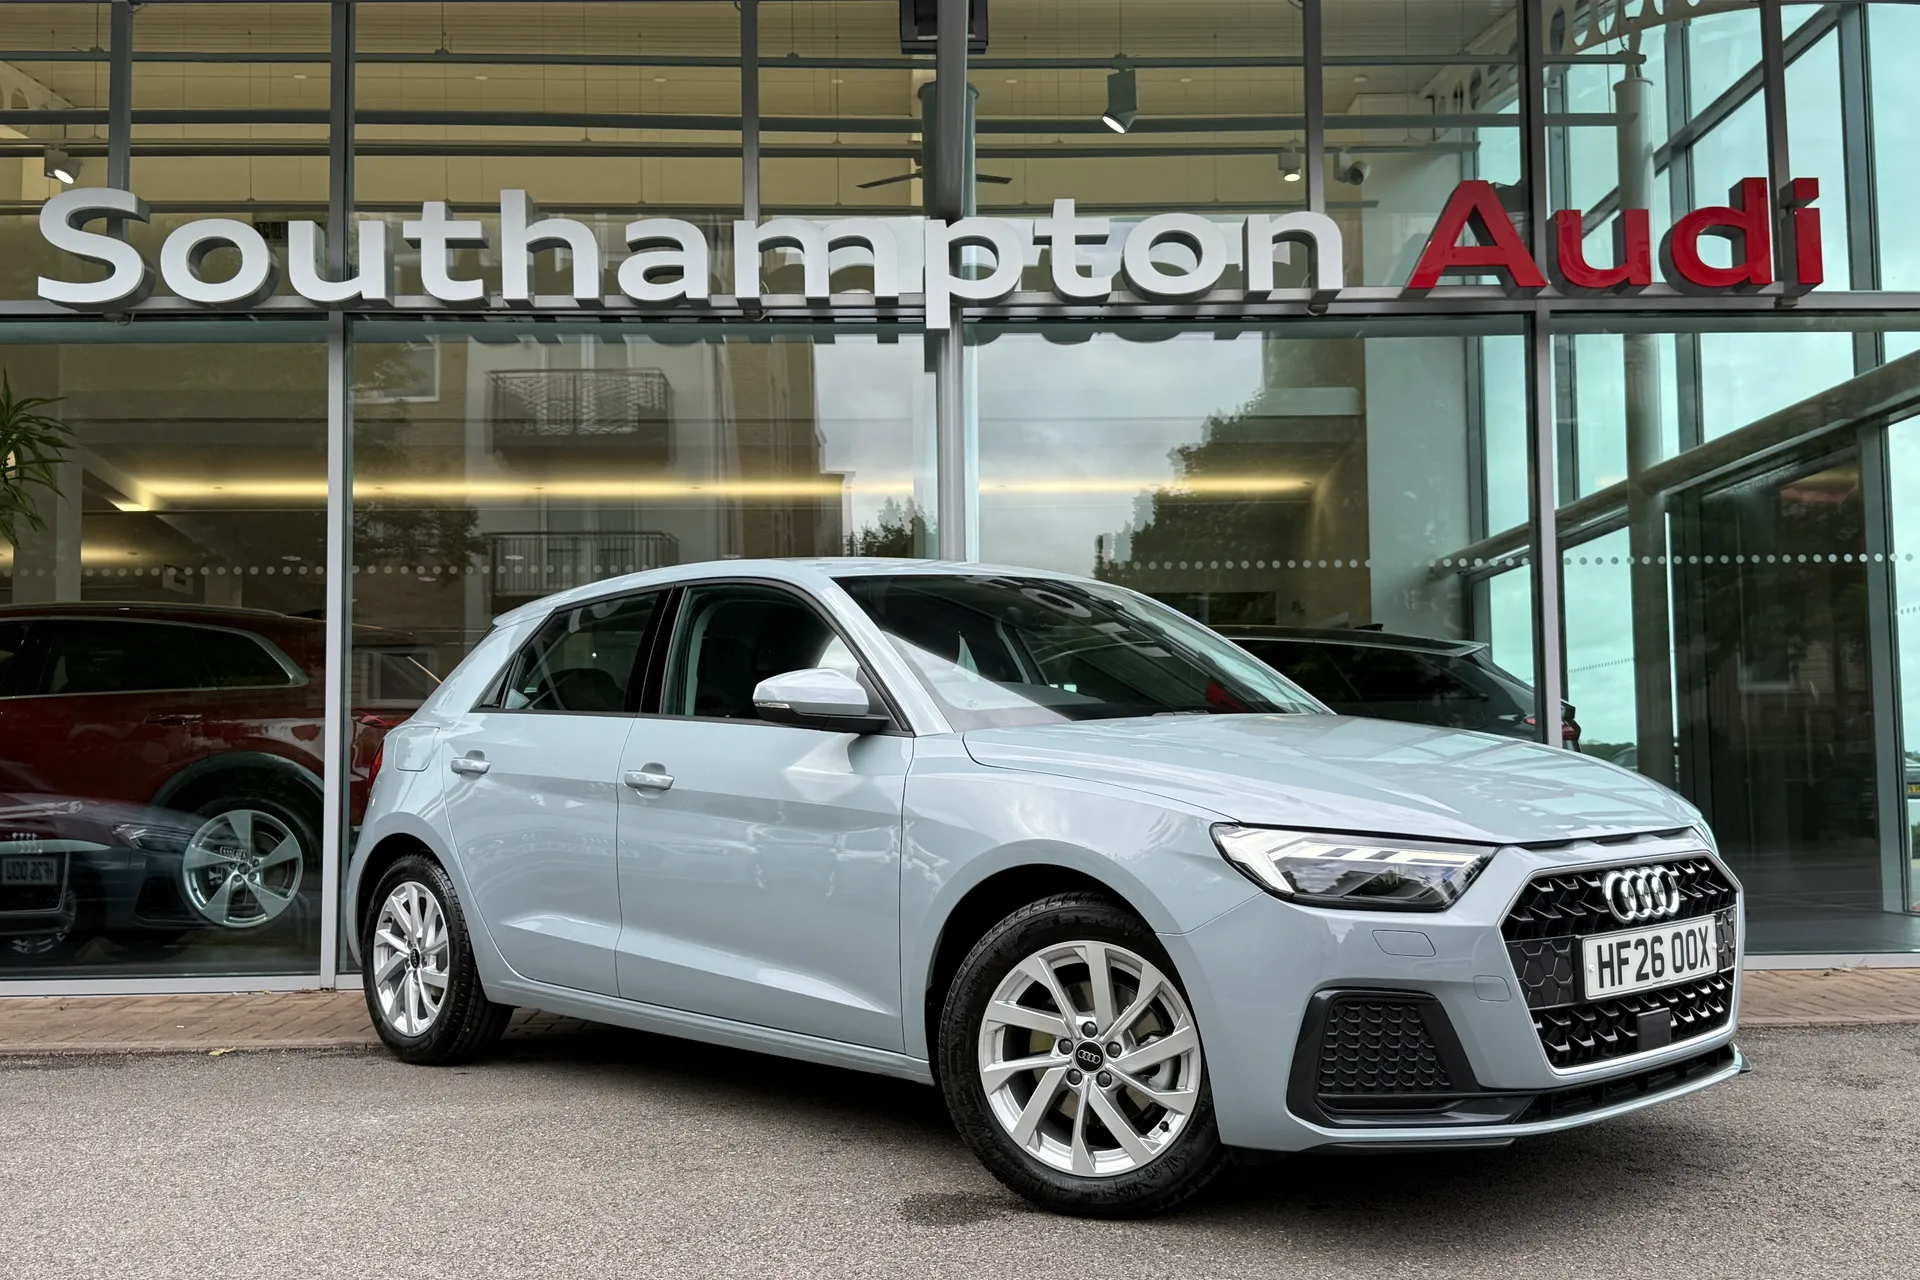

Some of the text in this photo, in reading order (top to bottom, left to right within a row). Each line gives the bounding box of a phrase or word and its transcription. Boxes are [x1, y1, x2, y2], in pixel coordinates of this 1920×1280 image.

[37, 176, 1824, 329] Southampton Audi
[1596, 925, 1711, 989] HF26 OOX
